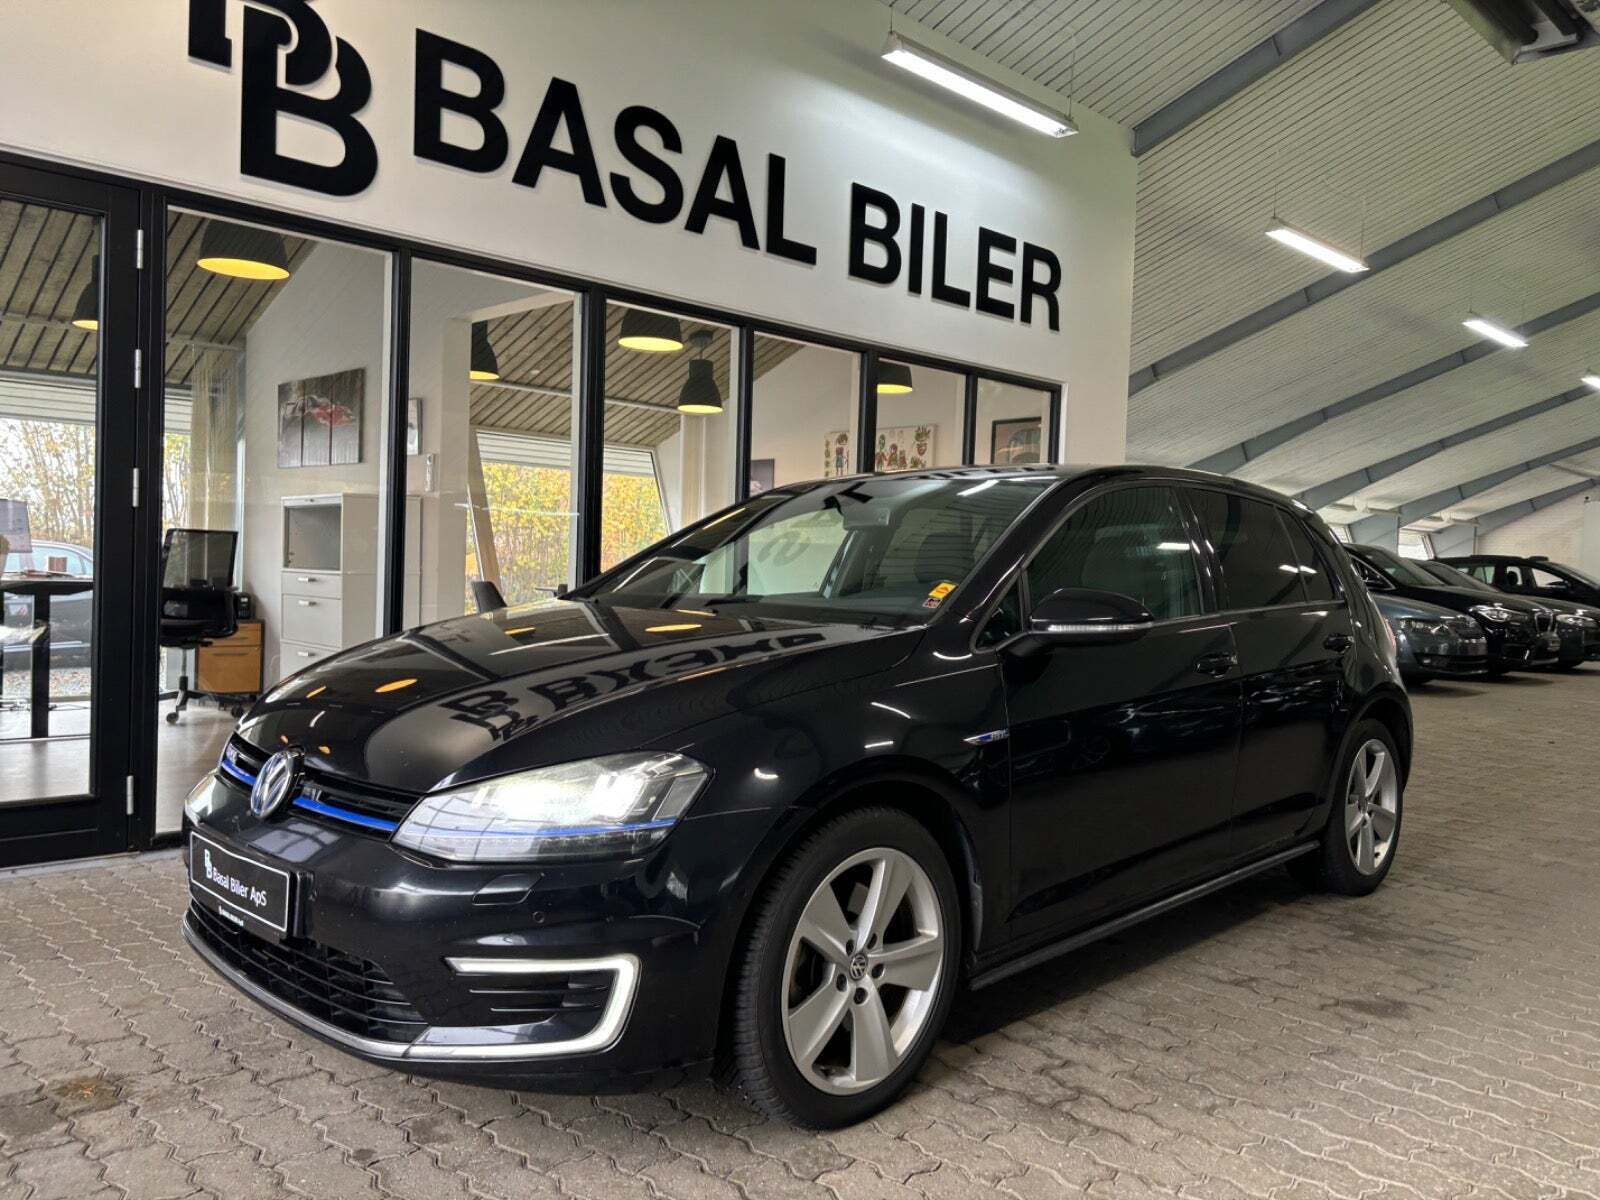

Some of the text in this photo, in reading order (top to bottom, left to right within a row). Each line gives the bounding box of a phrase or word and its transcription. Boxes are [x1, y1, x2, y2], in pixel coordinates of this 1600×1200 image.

[413, 28, 1062, 332] BASAL BILER
[213, 866, 267, 907] Basal Biler ApS
